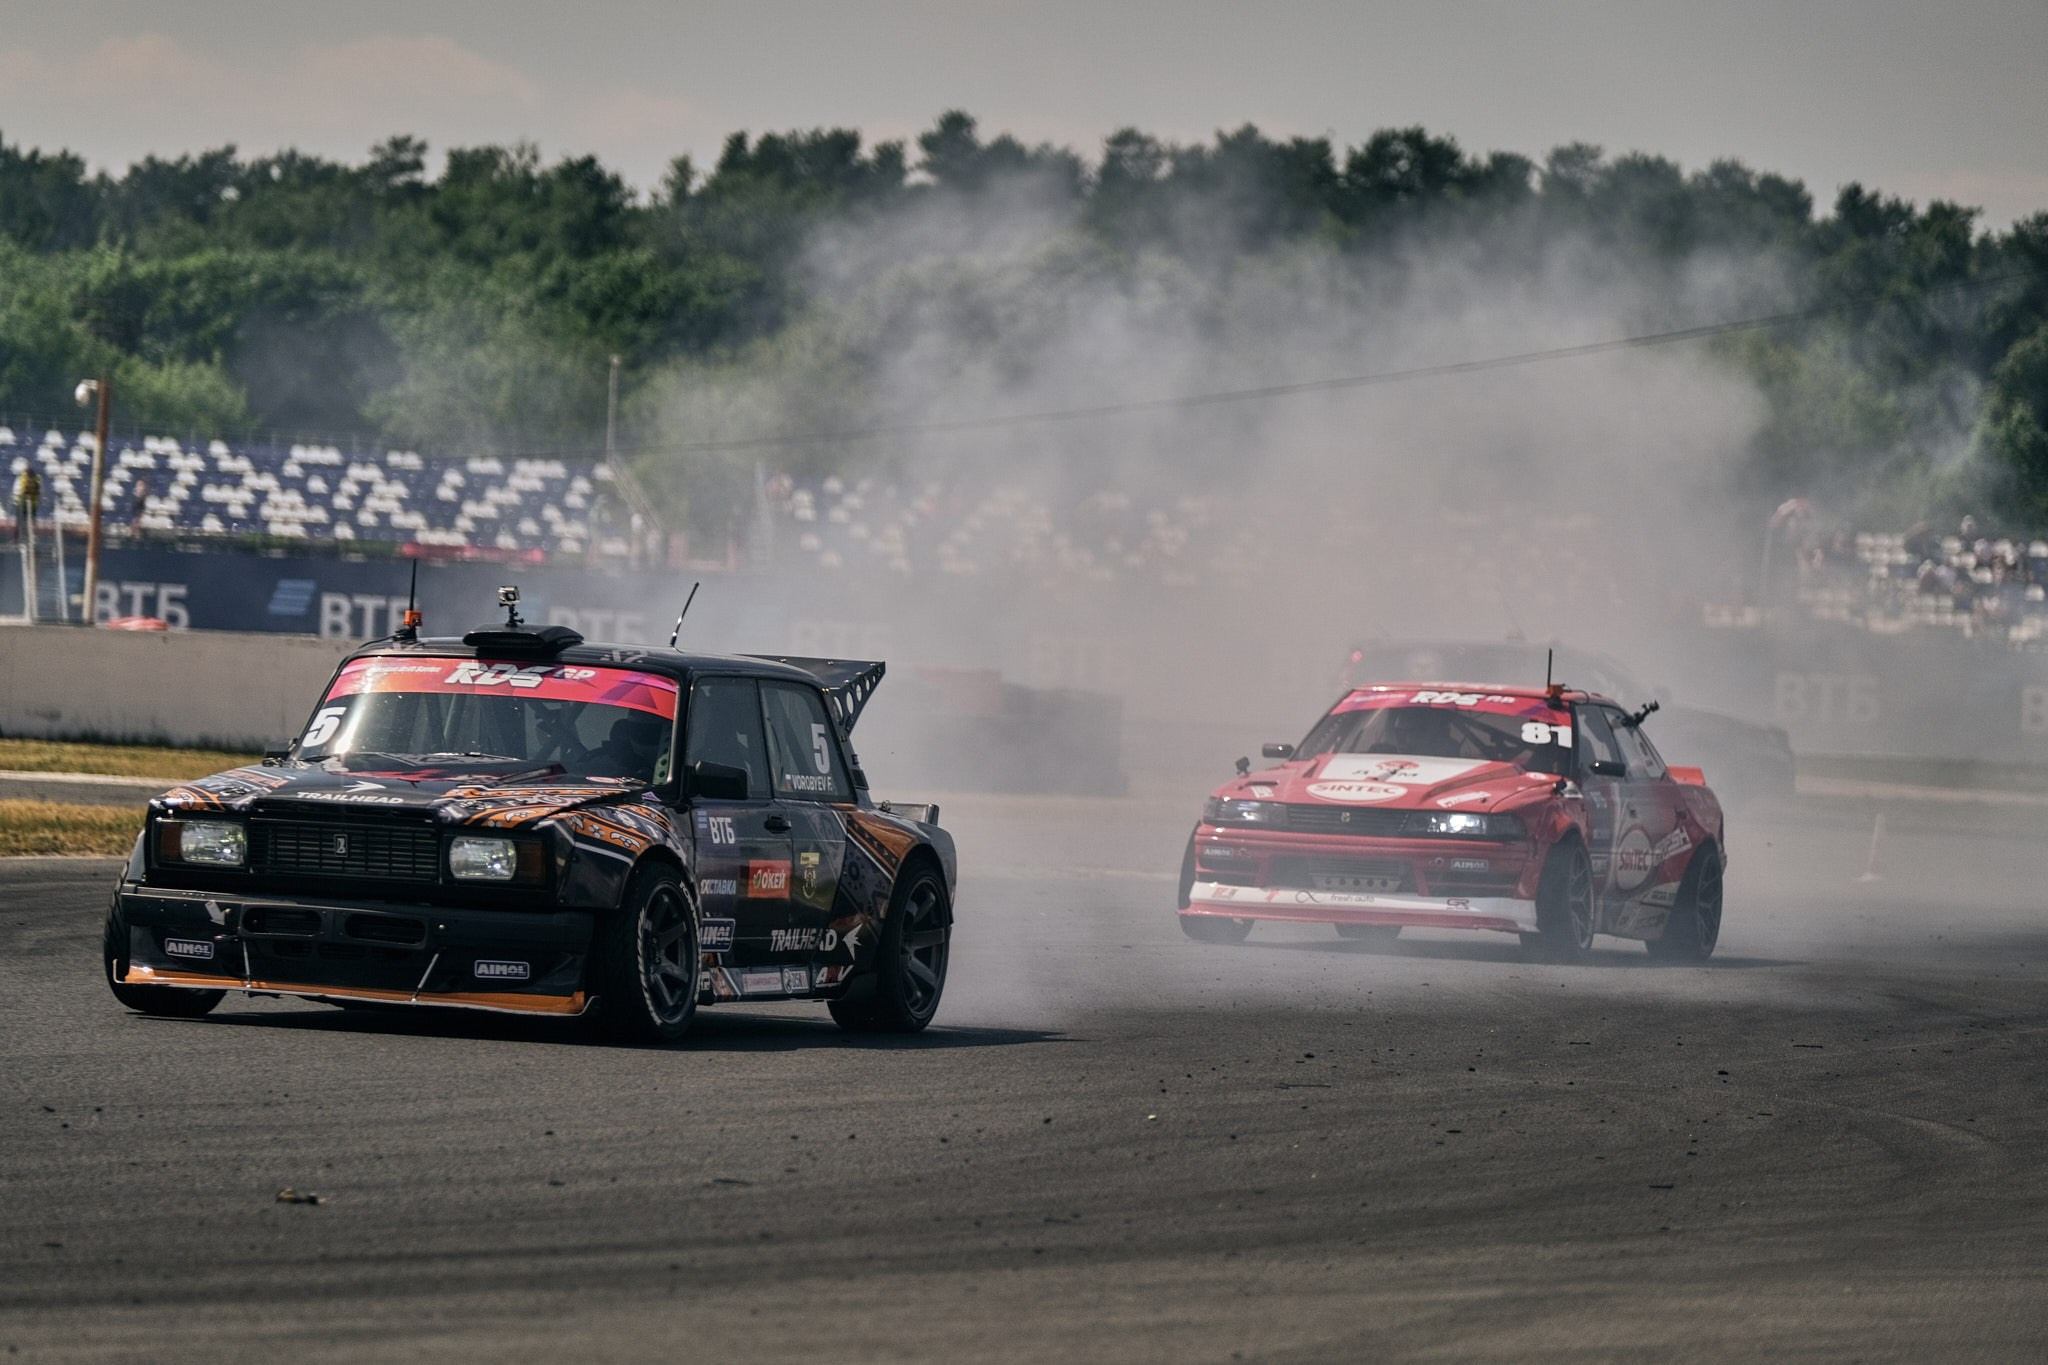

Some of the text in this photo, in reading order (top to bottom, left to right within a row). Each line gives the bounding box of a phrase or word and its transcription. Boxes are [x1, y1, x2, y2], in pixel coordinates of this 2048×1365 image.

[94, 580, 189, 628] ВТБ
[444, 662, 554, 688] RDS
[1410, 691, 1484, 706] RDS
[302, 706, 347, 748] 5
[1521, 722, 1572, 749] 81
[811, 723, 830, 774] 5
[792, 774, 826, 791] VOROBYEV
[1316, 783, 1397, 795] SINTEC
[297, 792, 404, 804] TRAILHEAD
[709, 816, 735, 844] ВТБ
[1452, 860, 1486, 869] AIMOL
[1618, 847, 1650, 872] SINTEC
[1331, 892, 1375, 904] fresh auto
[167, 942, 211, 954] AIMOL
[769, 928, 838, 951] TRAILHEAD
[477, 963, 527, 975] AIMOL
